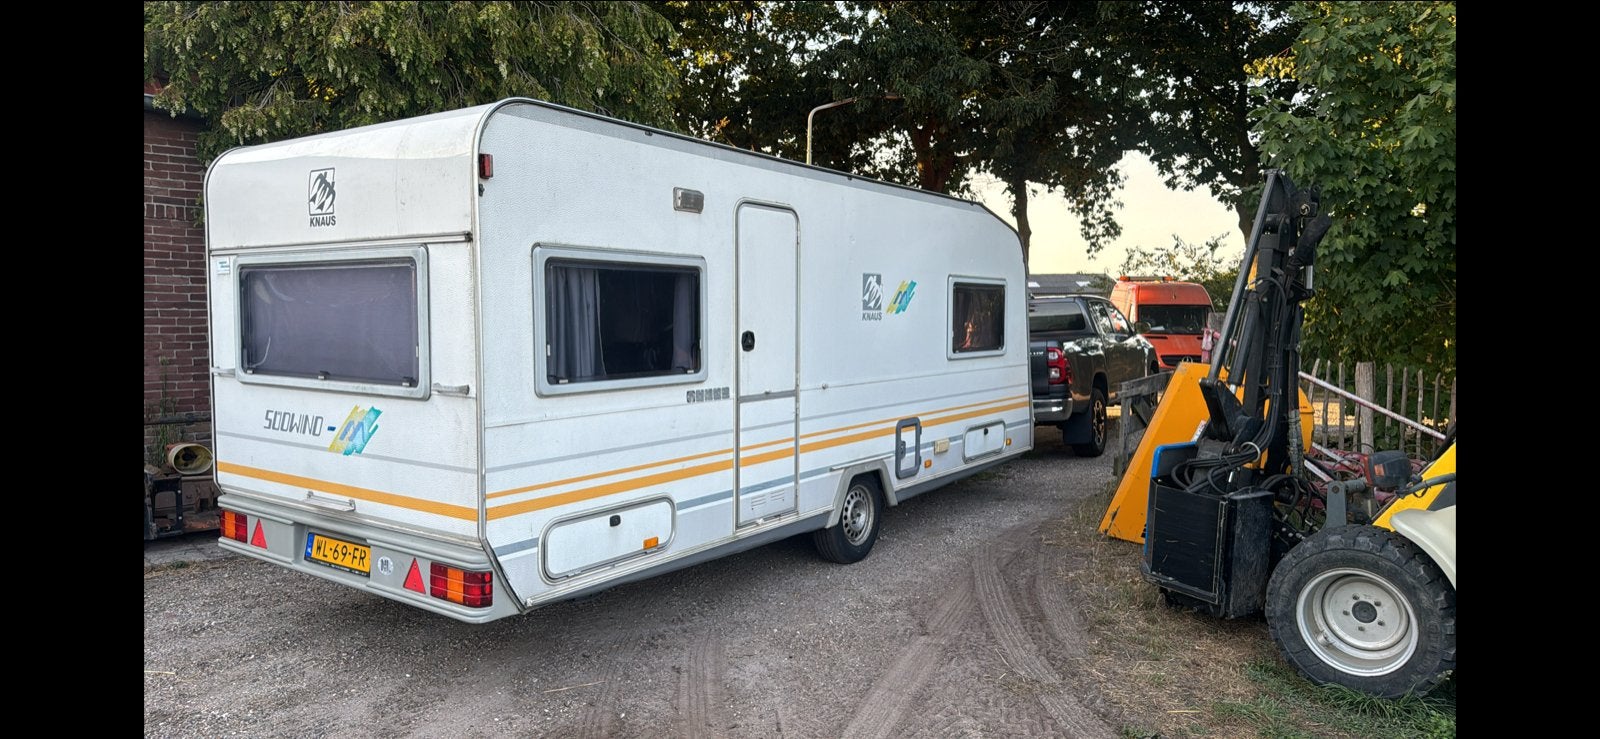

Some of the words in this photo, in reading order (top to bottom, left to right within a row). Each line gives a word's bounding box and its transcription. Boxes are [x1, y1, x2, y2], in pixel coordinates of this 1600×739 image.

[310, 216, 336, 227] KNAUS
[862, 312, 882, 320] KNAUS
[316, 539, 367, 567] WL-69-FR
